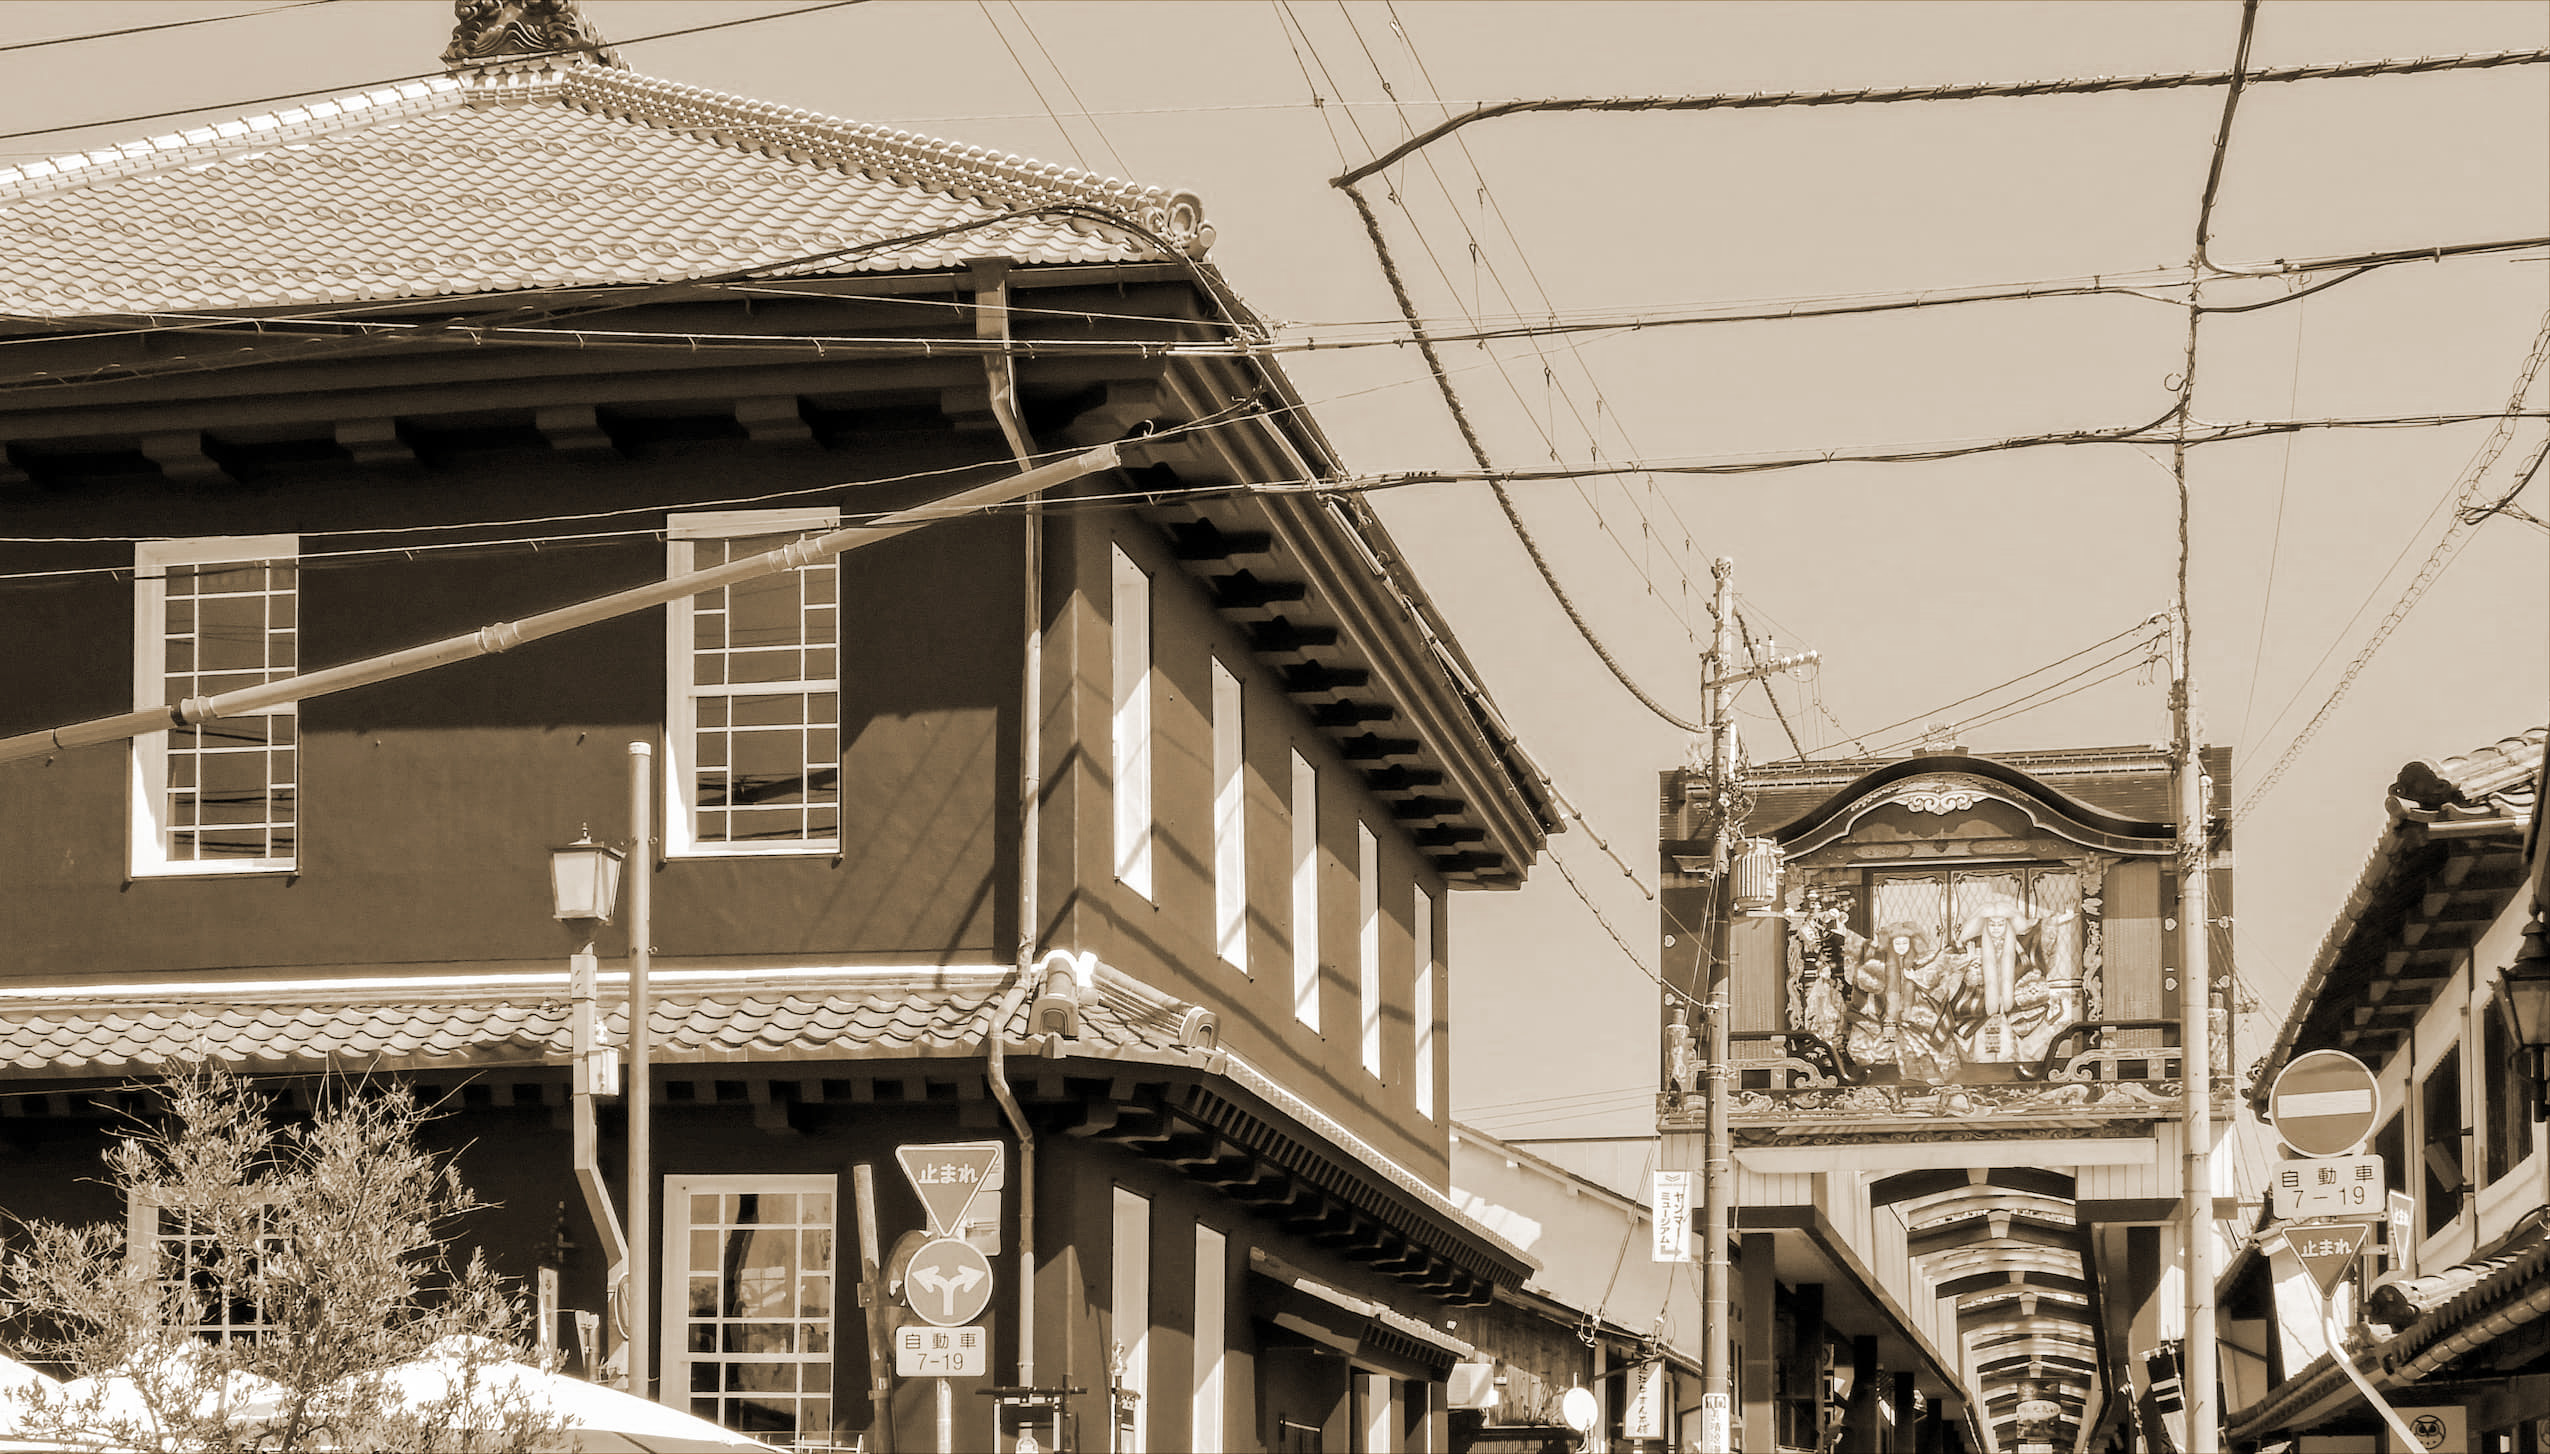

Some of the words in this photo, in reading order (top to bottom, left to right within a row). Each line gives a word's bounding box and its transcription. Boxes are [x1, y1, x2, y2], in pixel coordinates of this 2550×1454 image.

[918, 1163, 979, 1184] 止まれ
[2281, 1165, 2375, 1188] 自動車
[2293, 1185, 2365, 1209] 7-19
[2301, 1238, 2353, 1258] 止まれ
[905, 1332, 978, 1350] 自動車
[917, 1353, 965, 1371] 7-19
